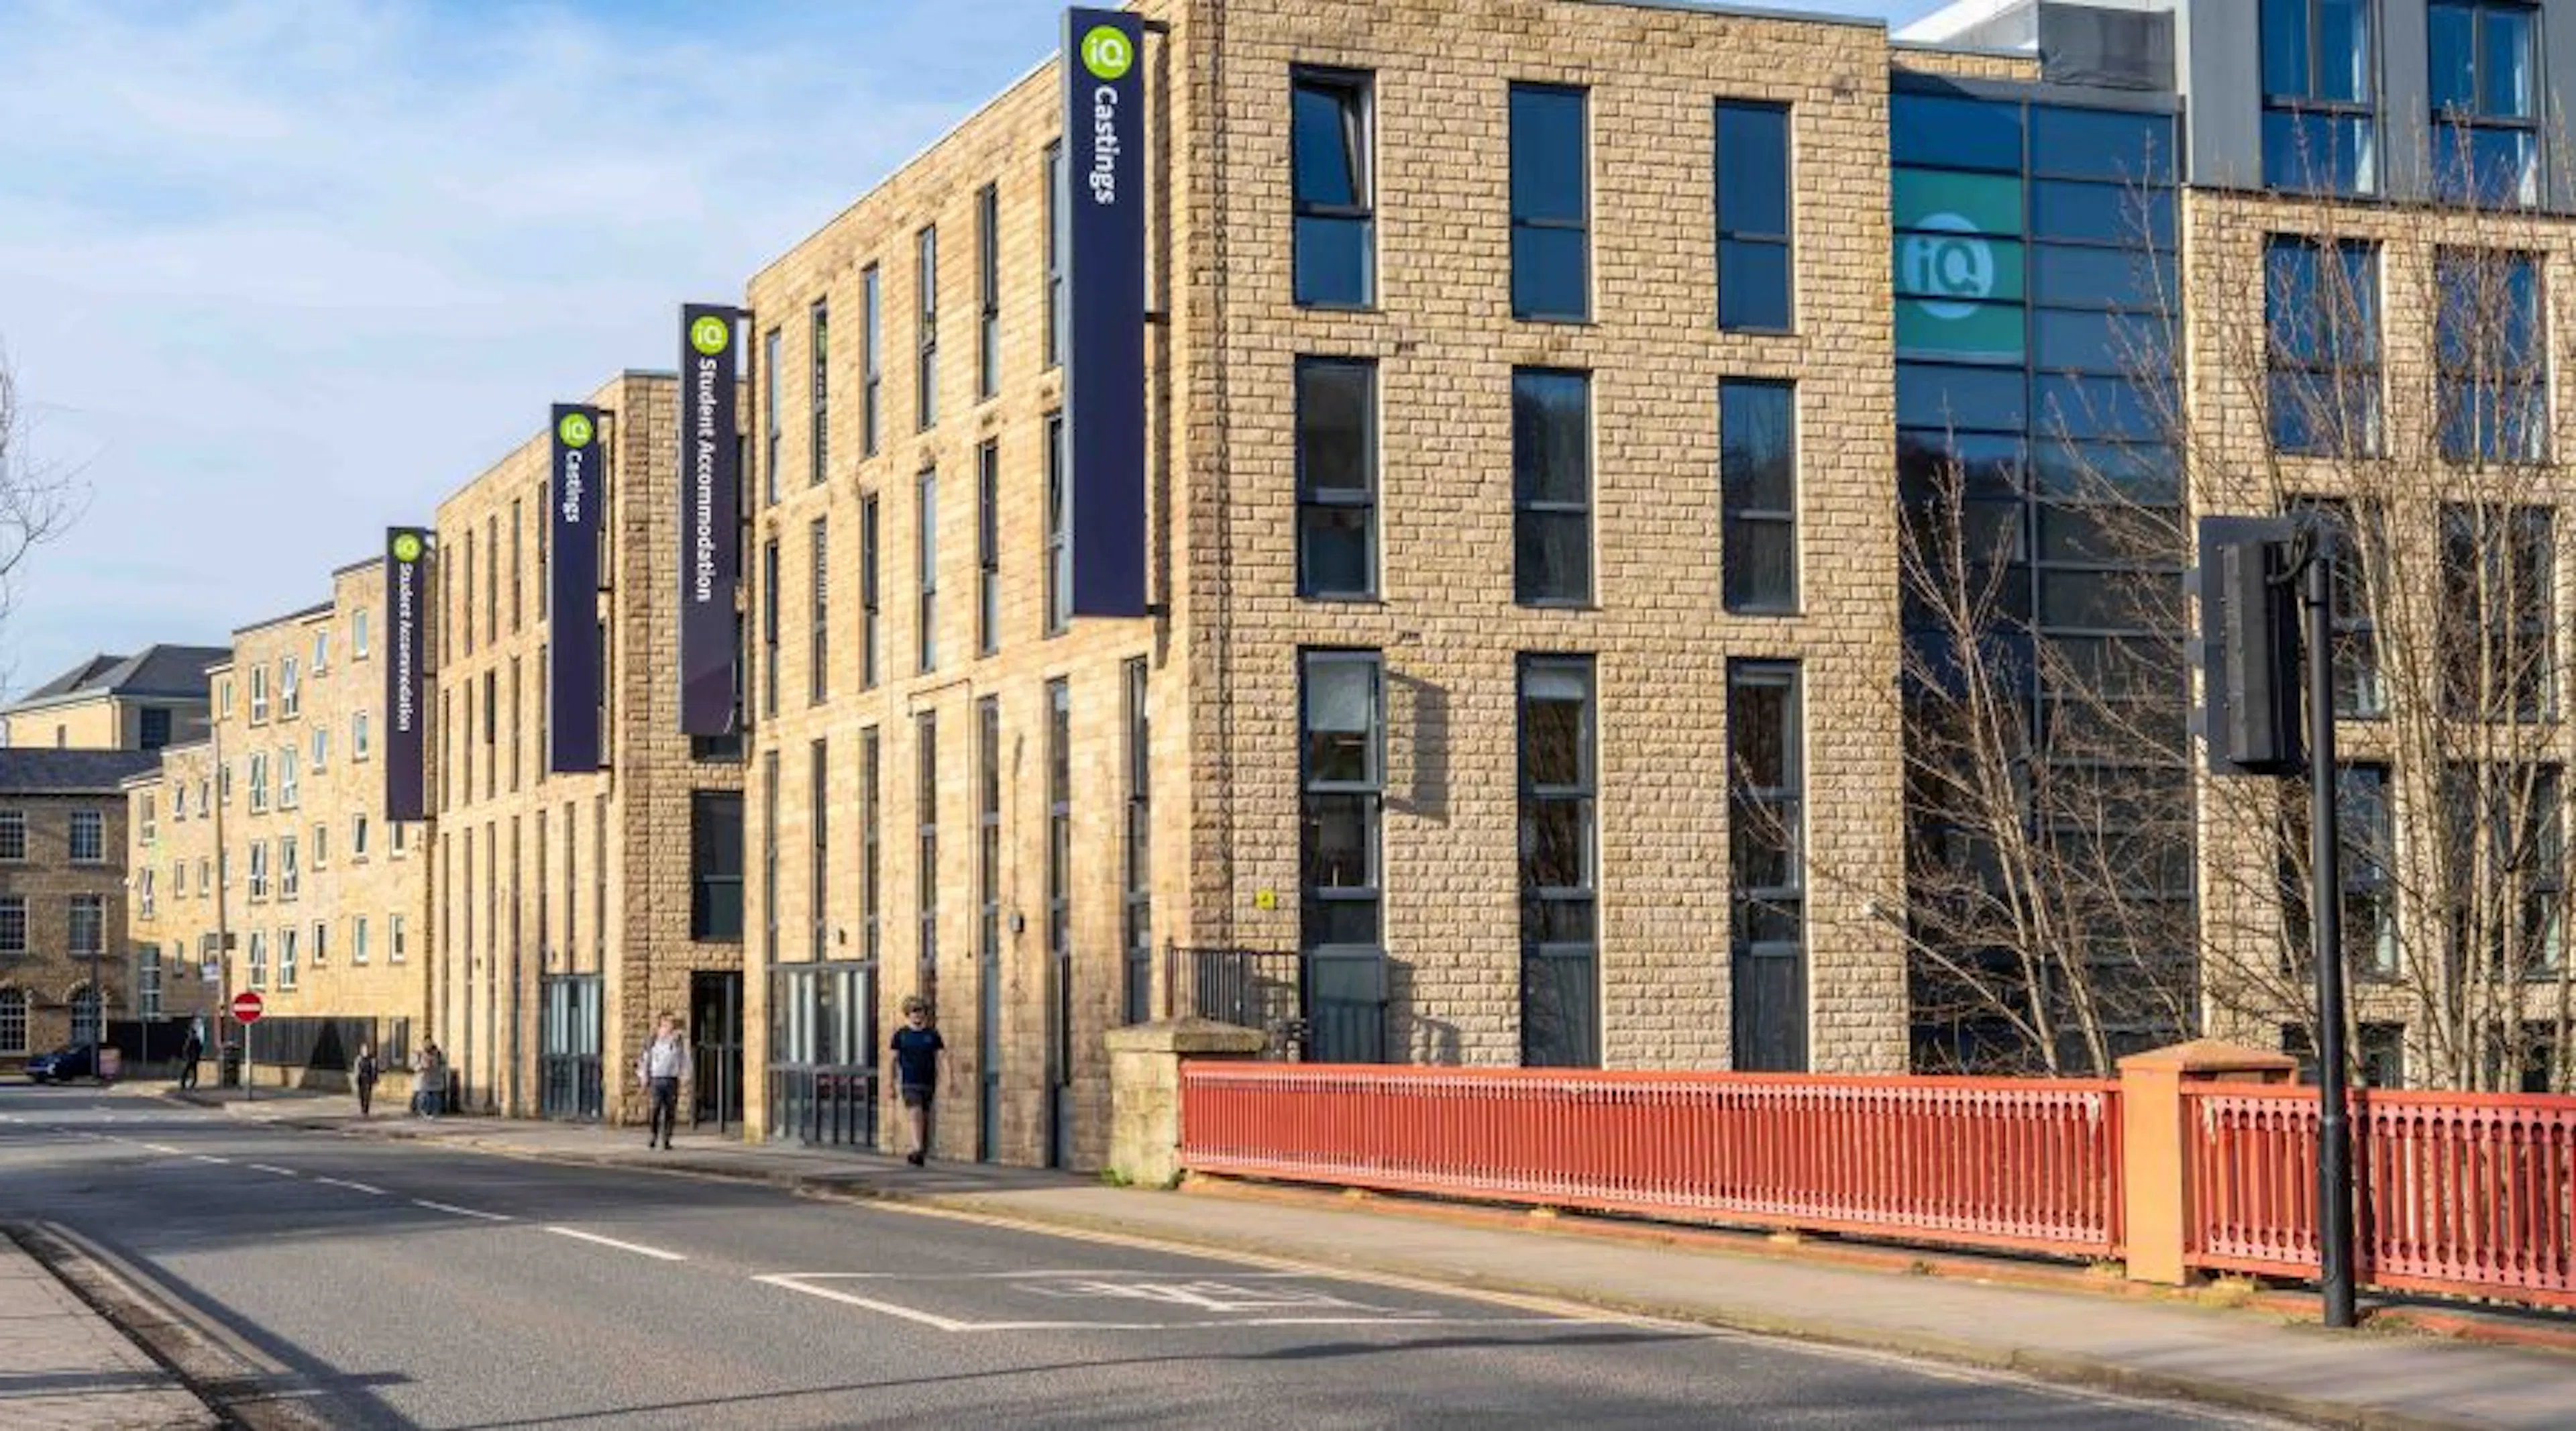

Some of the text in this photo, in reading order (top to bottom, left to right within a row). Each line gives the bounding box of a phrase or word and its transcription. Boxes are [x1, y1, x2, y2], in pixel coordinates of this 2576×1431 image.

[1091, 37, 1124, 68] iQ
[1089, 85, 1121, 205] Castings
[1918, 237, 1980, 294] iQ
[697, 324, 722, 345] iQ
[566, 421, 588, 440] iQ
[562, 449, 585, 523] Castings
[697, 357, 718, 602] Student Accommodation
[398, 562, 414, 731] Student Accommodation
